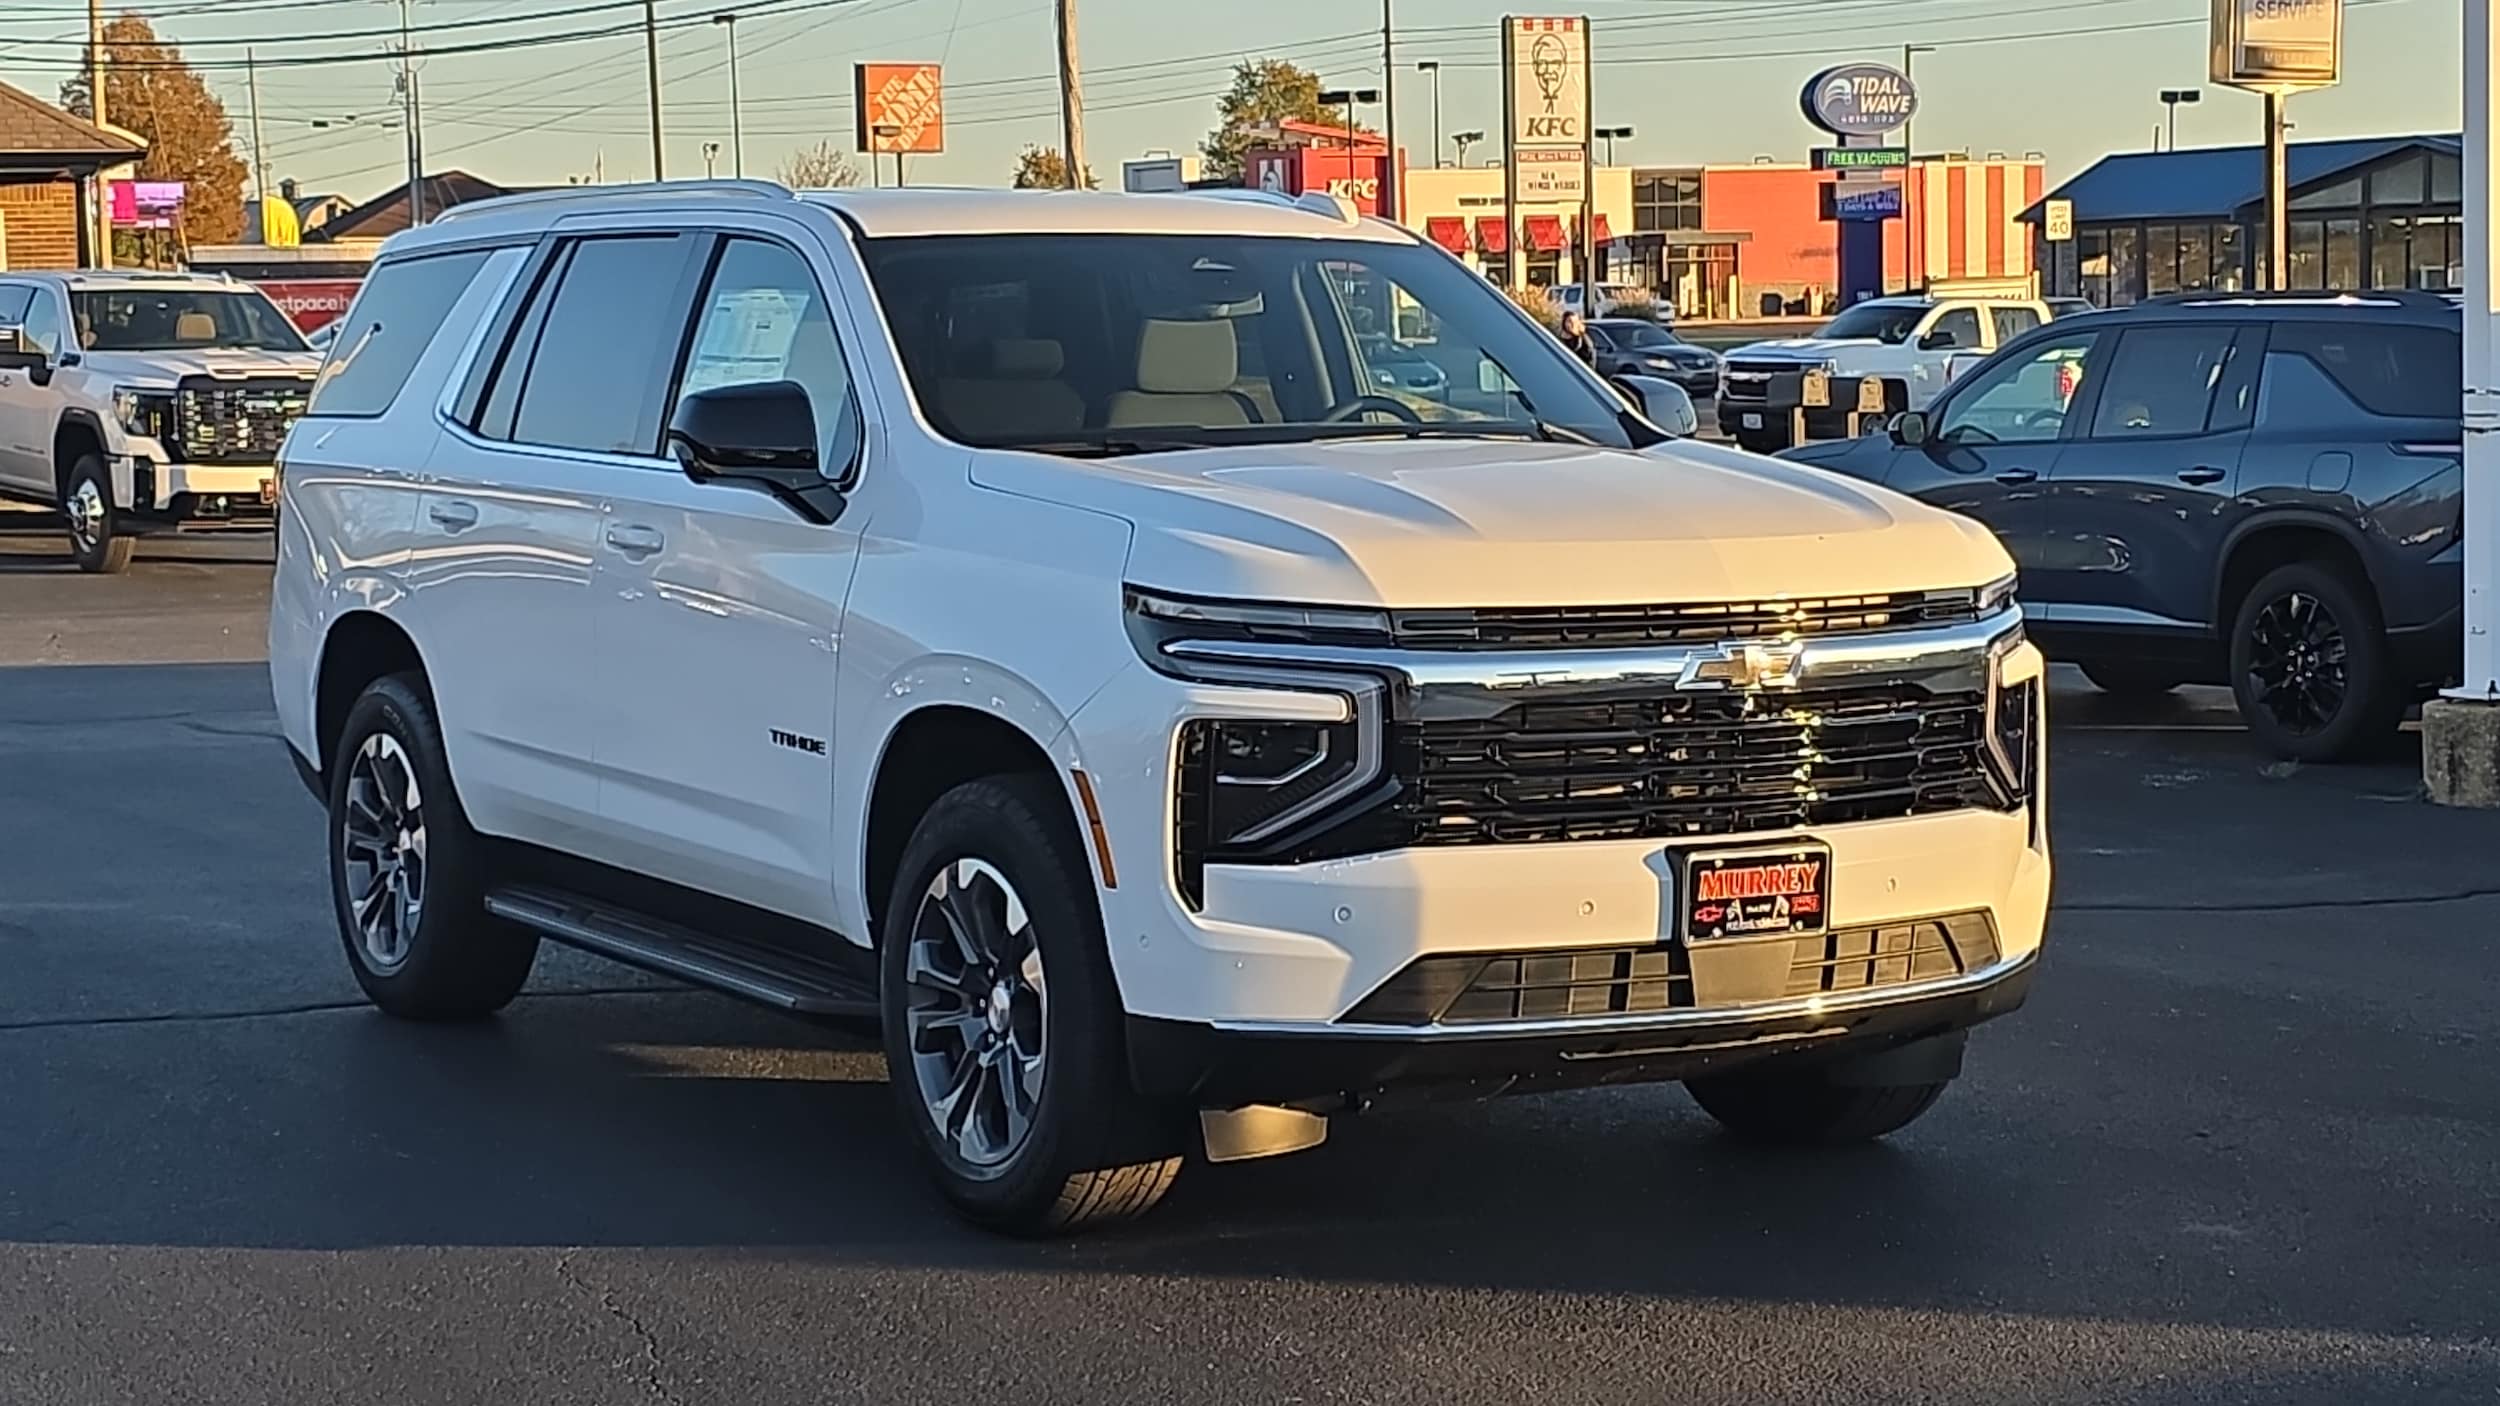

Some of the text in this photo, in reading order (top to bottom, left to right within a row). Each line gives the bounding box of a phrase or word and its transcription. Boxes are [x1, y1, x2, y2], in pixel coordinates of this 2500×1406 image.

[2255, 0, 2325, 20] SERVICE
[873, 75, 905, 109] THE
[1852, 77, 1900, 95] TIDAL
[1861, 95, 1911, 114] WAVE
[897, 101, 940, 149] DEPOT
[1526, 117, 1576, 137] KFC
[1828, 151, 1905, 165] FREE VACUUMS
[1328, 178, 1378, 199] KFC
[2050, 222, 2068, 234] 40
[769, 728, 826, 756] TAHOE
[1698, 861, 1820, 901] MURREY
